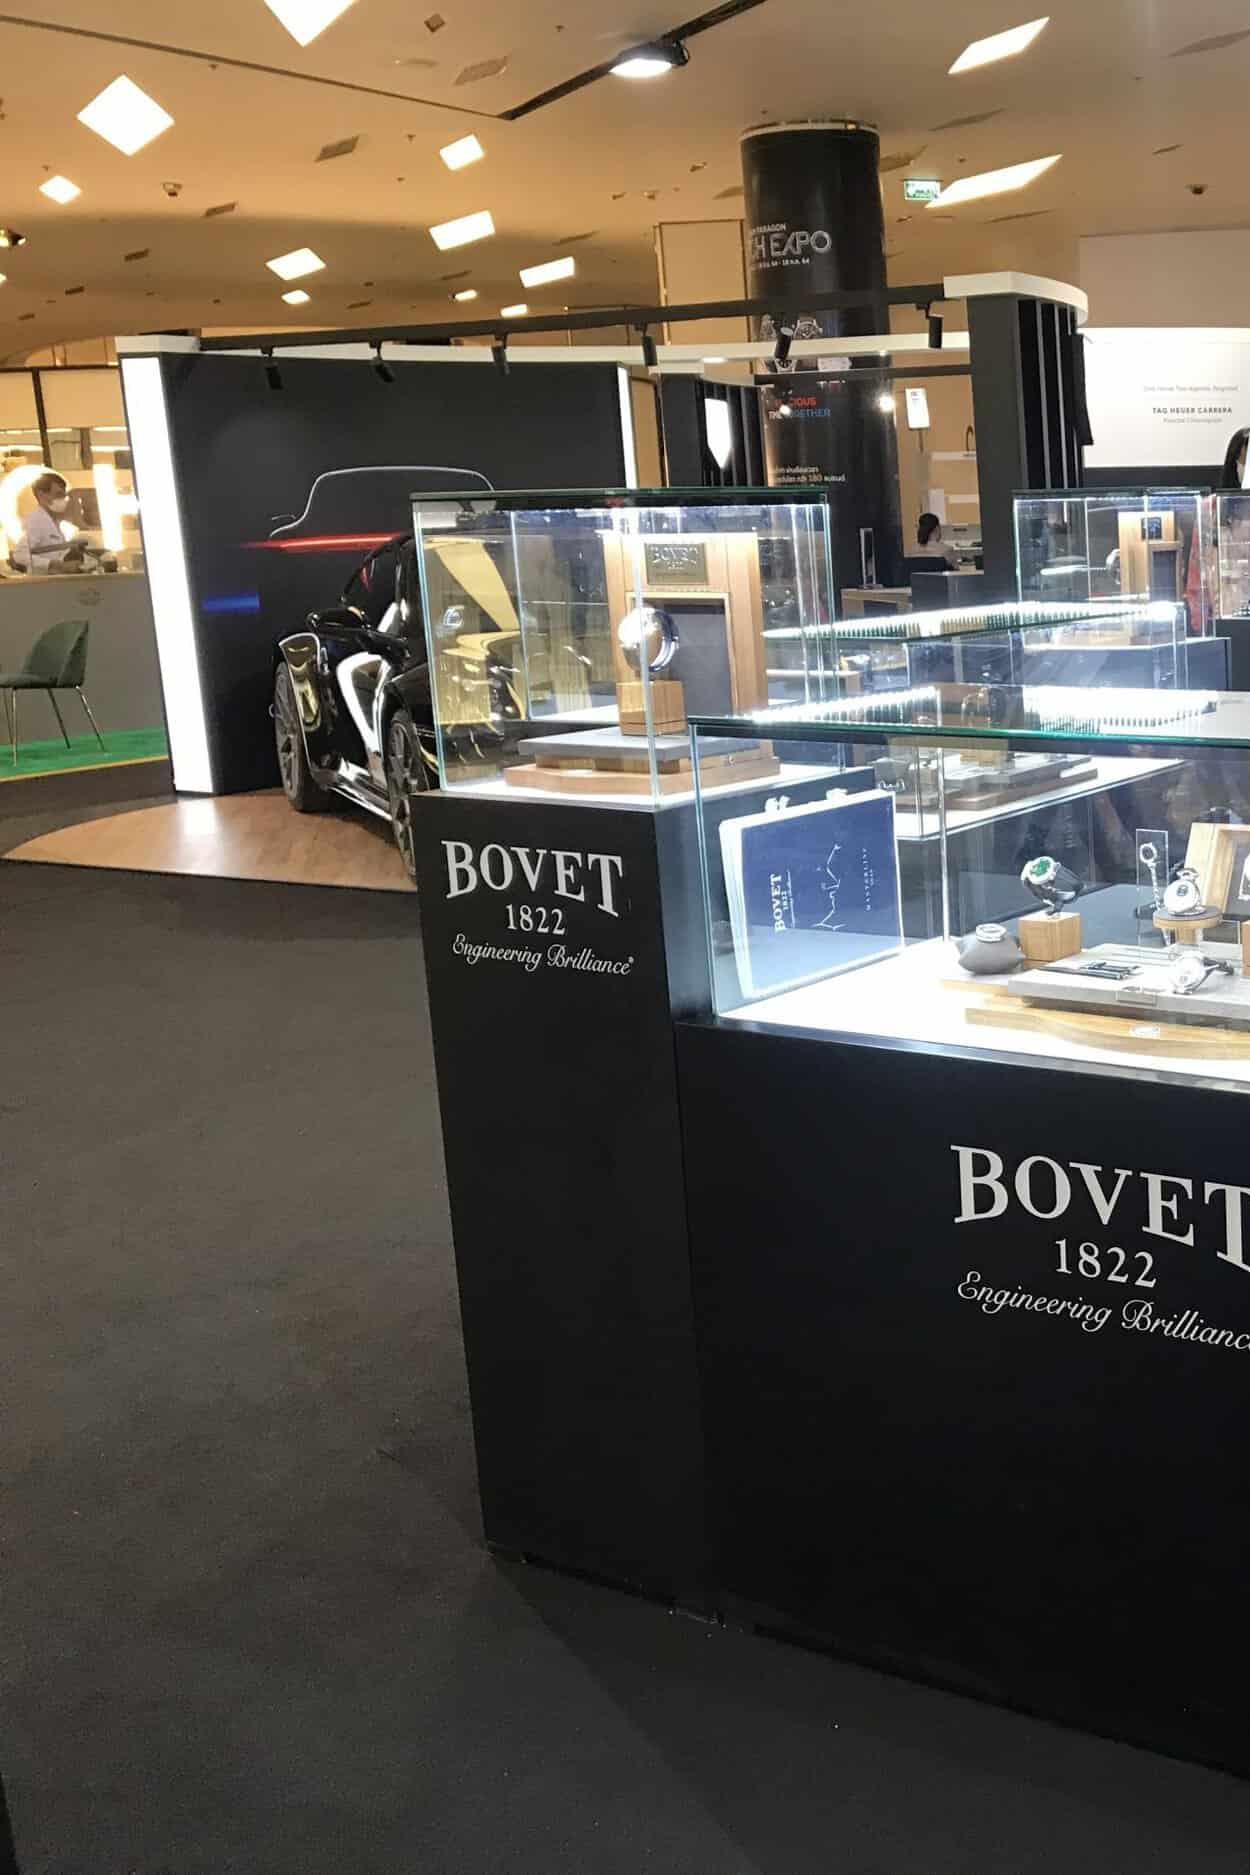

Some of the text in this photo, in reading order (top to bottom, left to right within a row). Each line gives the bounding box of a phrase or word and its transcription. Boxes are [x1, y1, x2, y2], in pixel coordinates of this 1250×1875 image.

[441, 840, 623, 917] BOVET
[770, 874, 787, 933] BOVET
[506, 904, 566, 935] 1822
[452, 933, 543, 972] Engineering
[1055, 1238, 1157, 1288] 1822
[957, 1270, 1112, 1332] Engineering
